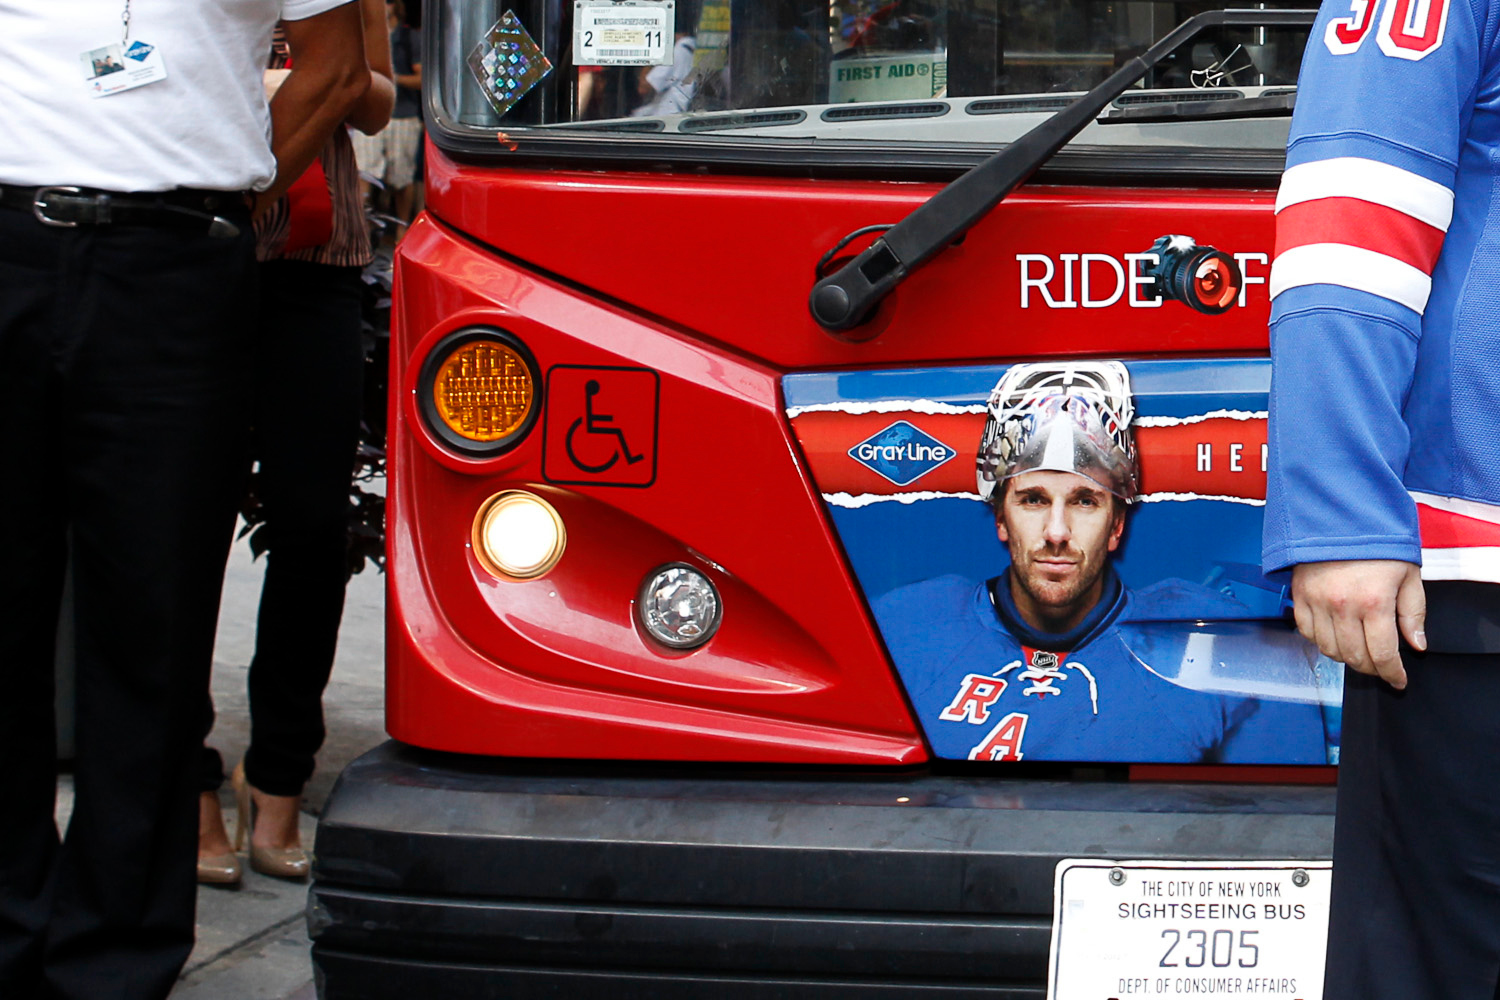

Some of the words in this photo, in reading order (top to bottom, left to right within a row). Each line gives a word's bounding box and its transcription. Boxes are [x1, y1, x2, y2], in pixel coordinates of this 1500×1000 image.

[584, 30, 593, 48] 2
[645, 31, 661, 48] 11
[836, 65, 882, 82] FIRST
[888, 63, 915, 78] AID
[1015, 253, 1163, 308] RIDE
[1142, 881, 1163, 897] THE
[1168, 881, 1194, 897] CITY
[1199, 881, 1214, 897] OF
[1218, 881, 1247, 898] NEW
[1249, 881, 1282, 898] YORK
[1117, 902, 1256, 920] SIGHTSEEING
[1264, 903, 1306, 920] BUS
[1158, 929, 1260, 968] 2305
[1118, 978, 1151, 994] DEPT.
[1156, 978, 1170, 994] OF
[1175, 978, 1242, 994] CONSUMER
[1246, 978, 1297, 994] AFFAIRS
